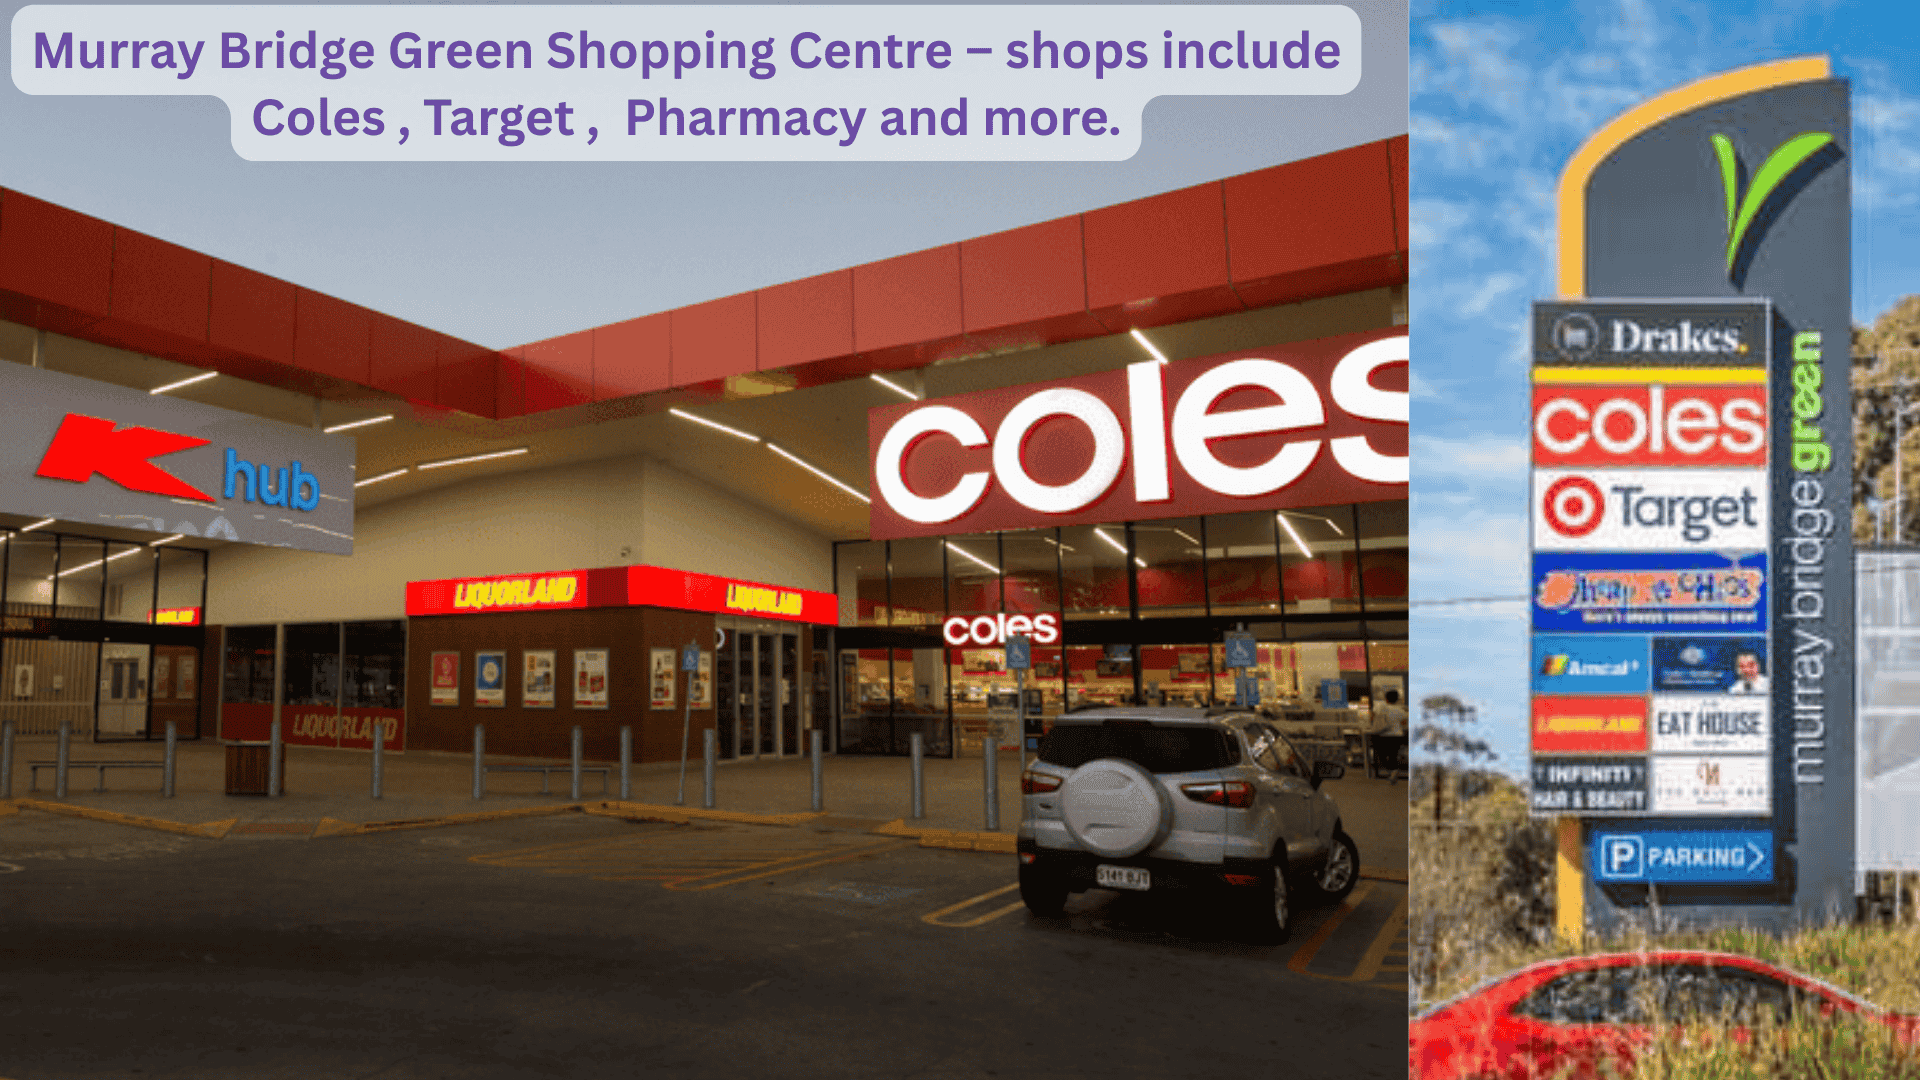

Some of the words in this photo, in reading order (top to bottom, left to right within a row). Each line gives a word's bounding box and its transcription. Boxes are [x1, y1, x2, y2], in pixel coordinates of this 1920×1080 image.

[1535, 385, 1764, 454] coles
[1791, 331, 1831, 472] green
[224, 447, 321, 511] hub
[1610, 485, 1757, 541] Target
[1784, 480, 1834, 618] bridge
[454, 576, 577, 609] LIQUORLAND
[943, 613, 1058, 645] coles
[1658, 711, 1693, 735] EAT
[1698, 711, 1762, 735] HOUSE
[1792, 629, 1833, 785] murray
[1611, 841, 1635, 872] P
[1649, 846, 1745, 868] PARKING
